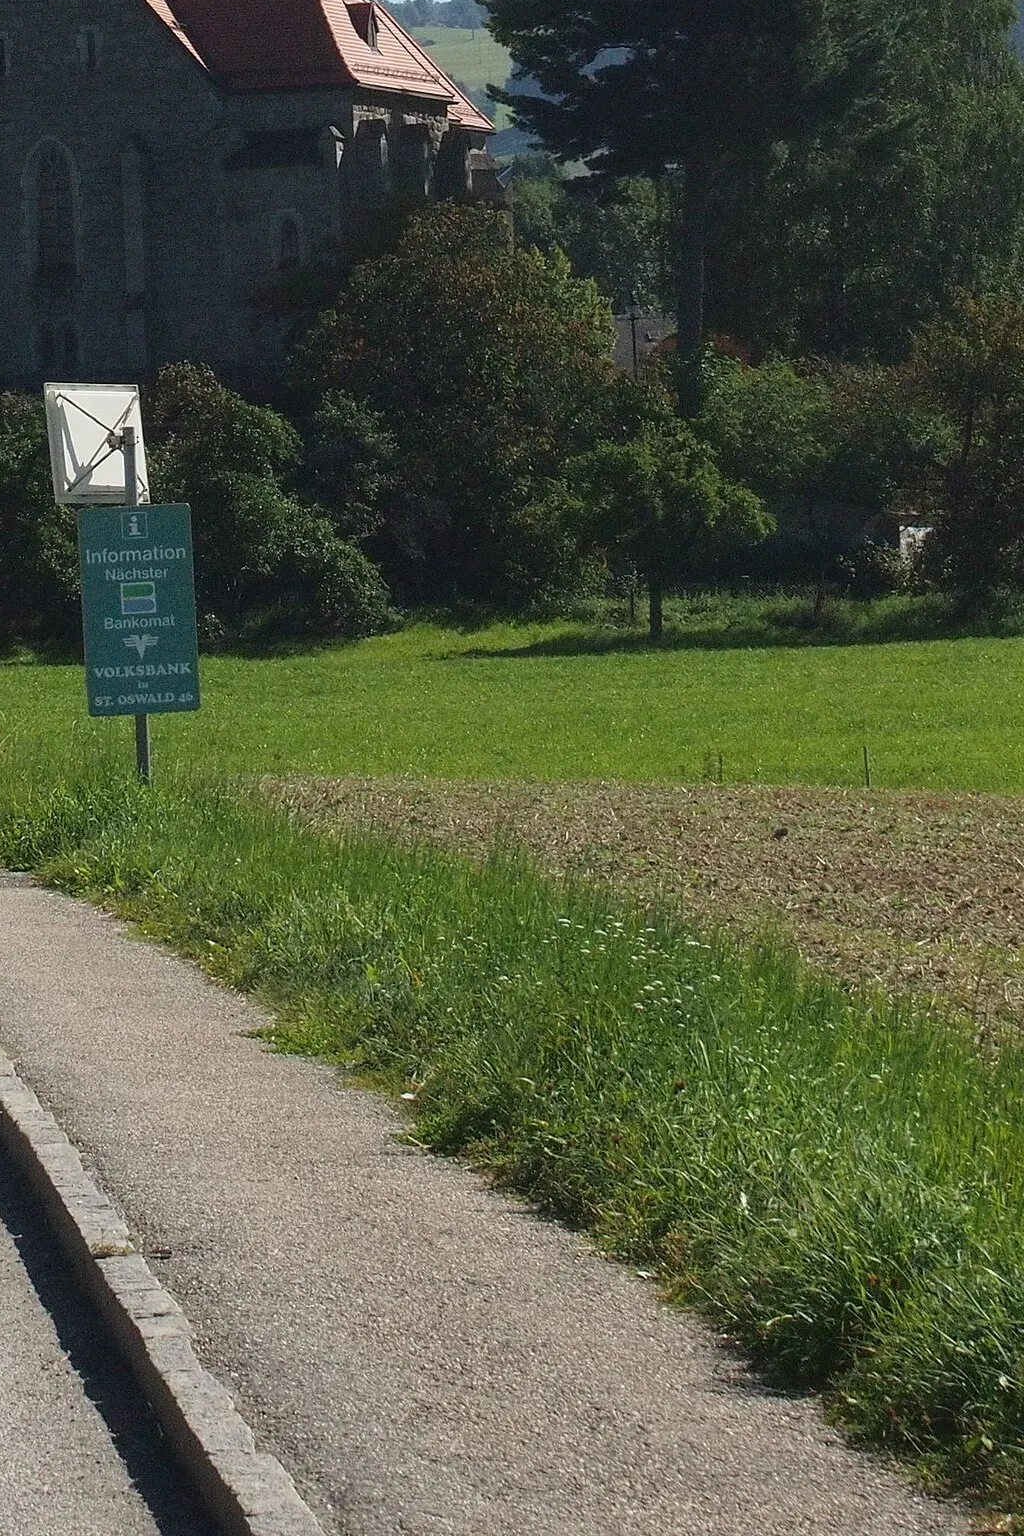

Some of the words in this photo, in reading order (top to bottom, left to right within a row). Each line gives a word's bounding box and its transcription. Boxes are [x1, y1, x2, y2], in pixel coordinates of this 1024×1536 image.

[86, 545, 186, 564] Information
[105, 567, 169, 581] Nächster
[104, 614, 176, 630] Bankomat
[93, 662, 192, 678] VOLKSBANK
[94, 695, 114, 706] ST.
[117, 692, 175, 705] OSWALD
